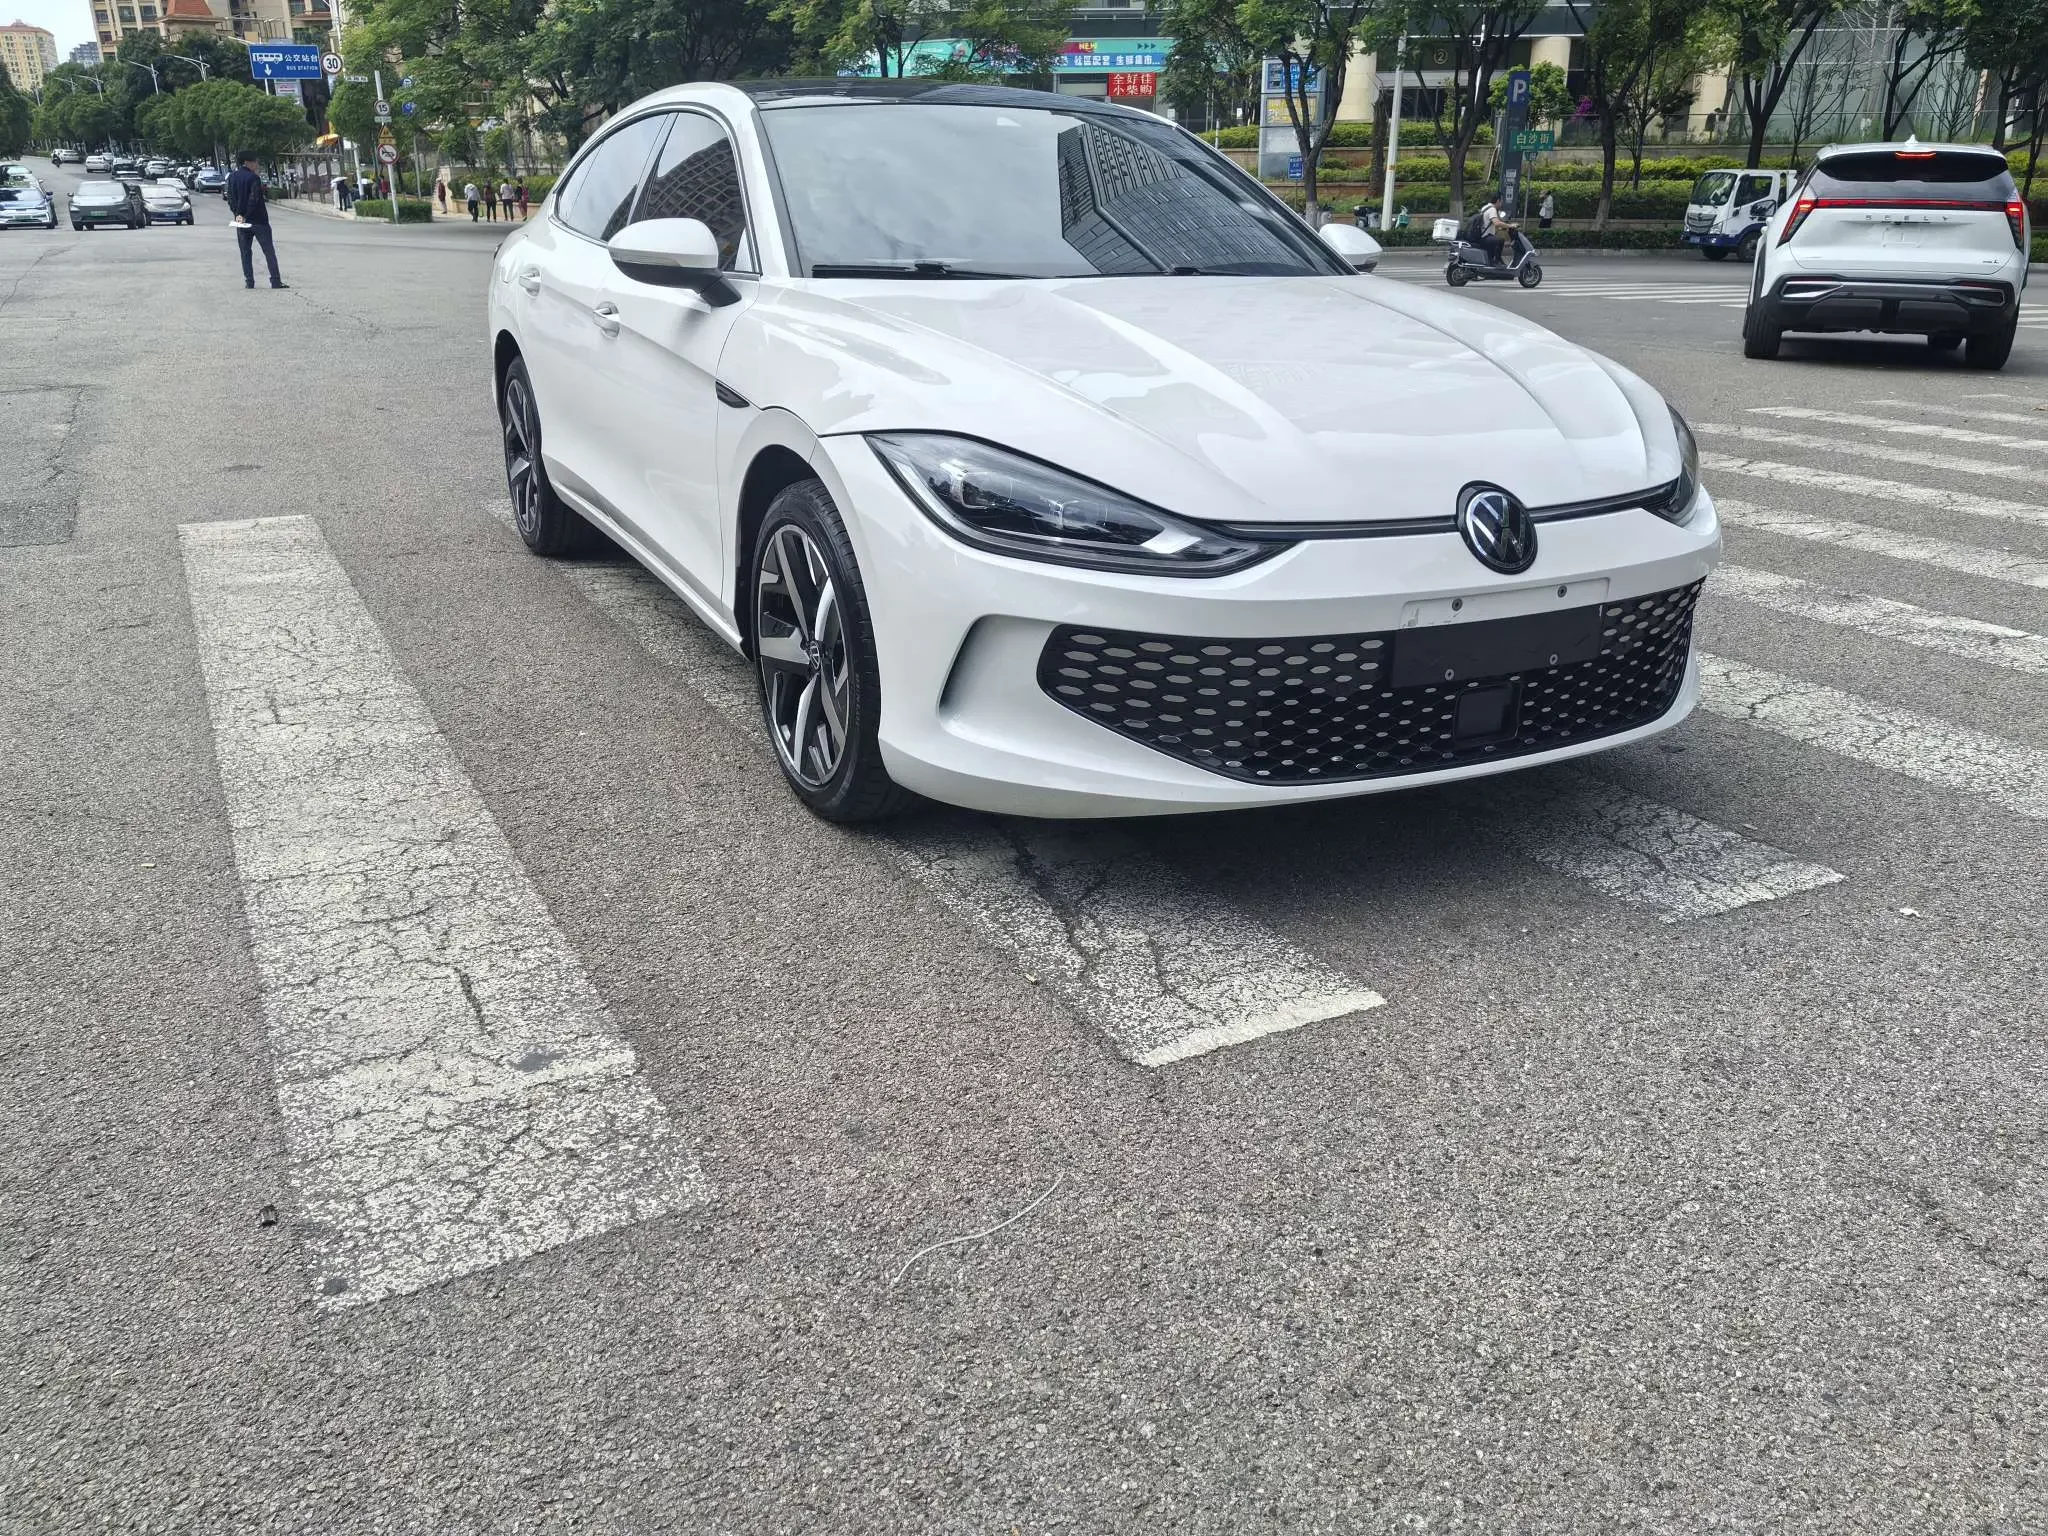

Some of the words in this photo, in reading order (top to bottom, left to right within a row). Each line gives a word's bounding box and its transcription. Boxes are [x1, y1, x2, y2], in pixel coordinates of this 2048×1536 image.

[326, 58, 338, 69] 30
[1513, 80, 1526, 102] P
[378, 104, 388, 113] 15
[1516, 133, 1549, 144] 白沙街
